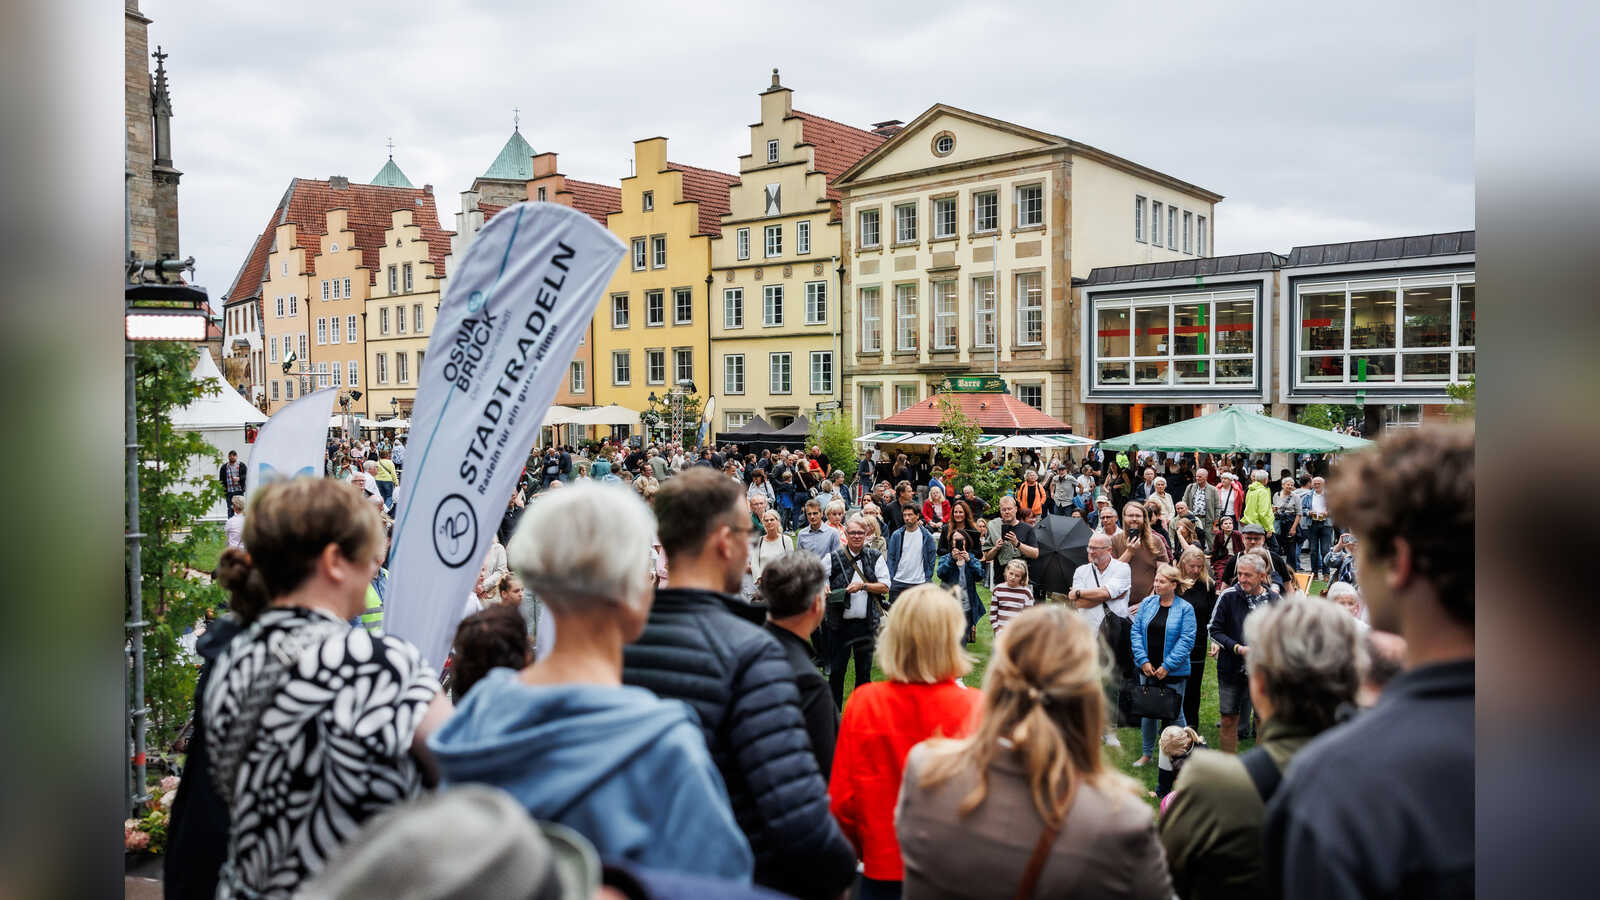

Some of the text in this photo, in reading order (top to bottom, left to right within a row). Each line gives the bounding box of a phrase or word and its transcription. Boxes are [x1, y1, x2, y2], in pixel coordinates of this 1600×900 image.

[443, 317, 479, 382] OSNA
[459, 240, 576, 486] STADTRADELN
[477, 450, 502, 495] Radeln
[497, 429, 511, 449] für
[508, 405, 520, 427] ein
[535, 324, 558, 361] Klima
